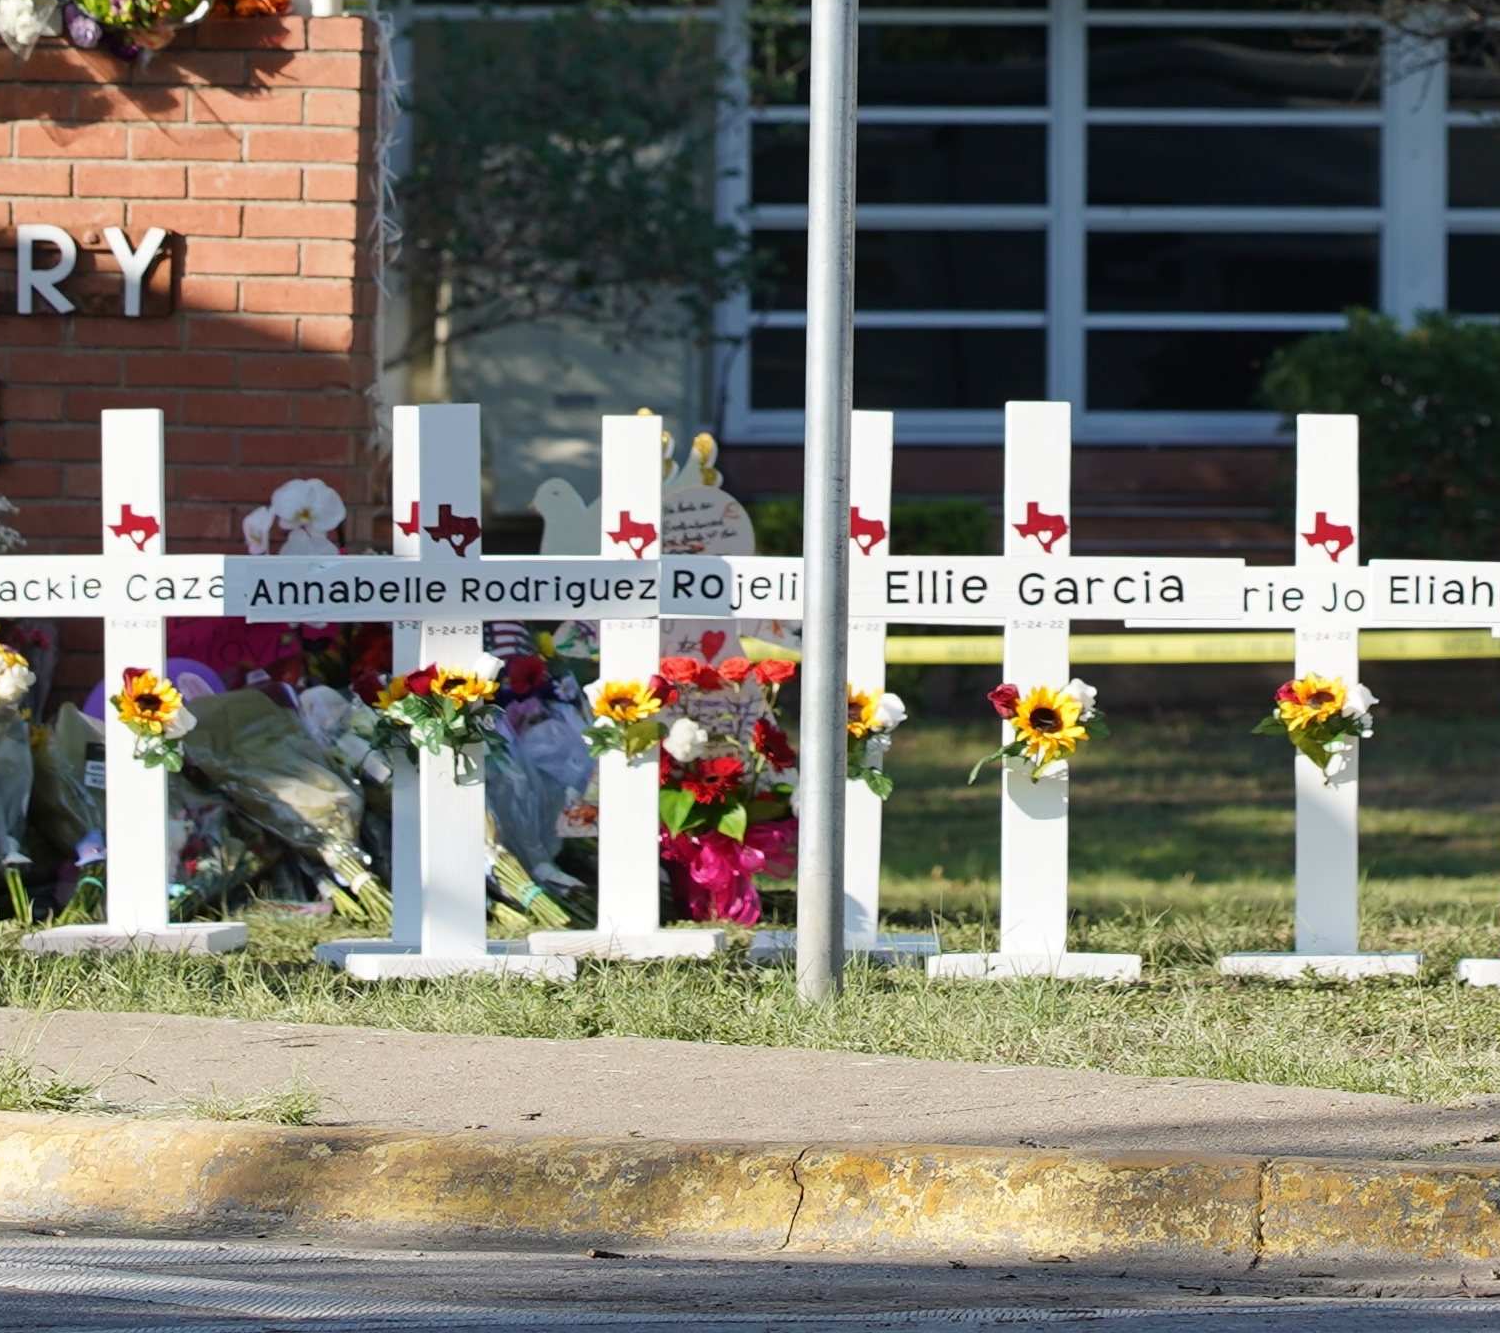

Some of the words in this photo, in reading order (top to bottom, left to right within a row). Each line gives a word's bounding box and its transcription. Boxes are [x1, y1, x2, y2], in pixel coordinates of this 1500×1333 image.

[251, 577, 446, 606] Annabelle
[462, 576, 656, 608] Rodriguez
[887, 570, 987, 603] Ellie
[1019, 571, 1183, 605] Garcia
[1322, 583, 1364, 612] Jo
[427, 626, 480, 636] 5-24-22
[1012, 620, 1065, 630] 5-24-22
